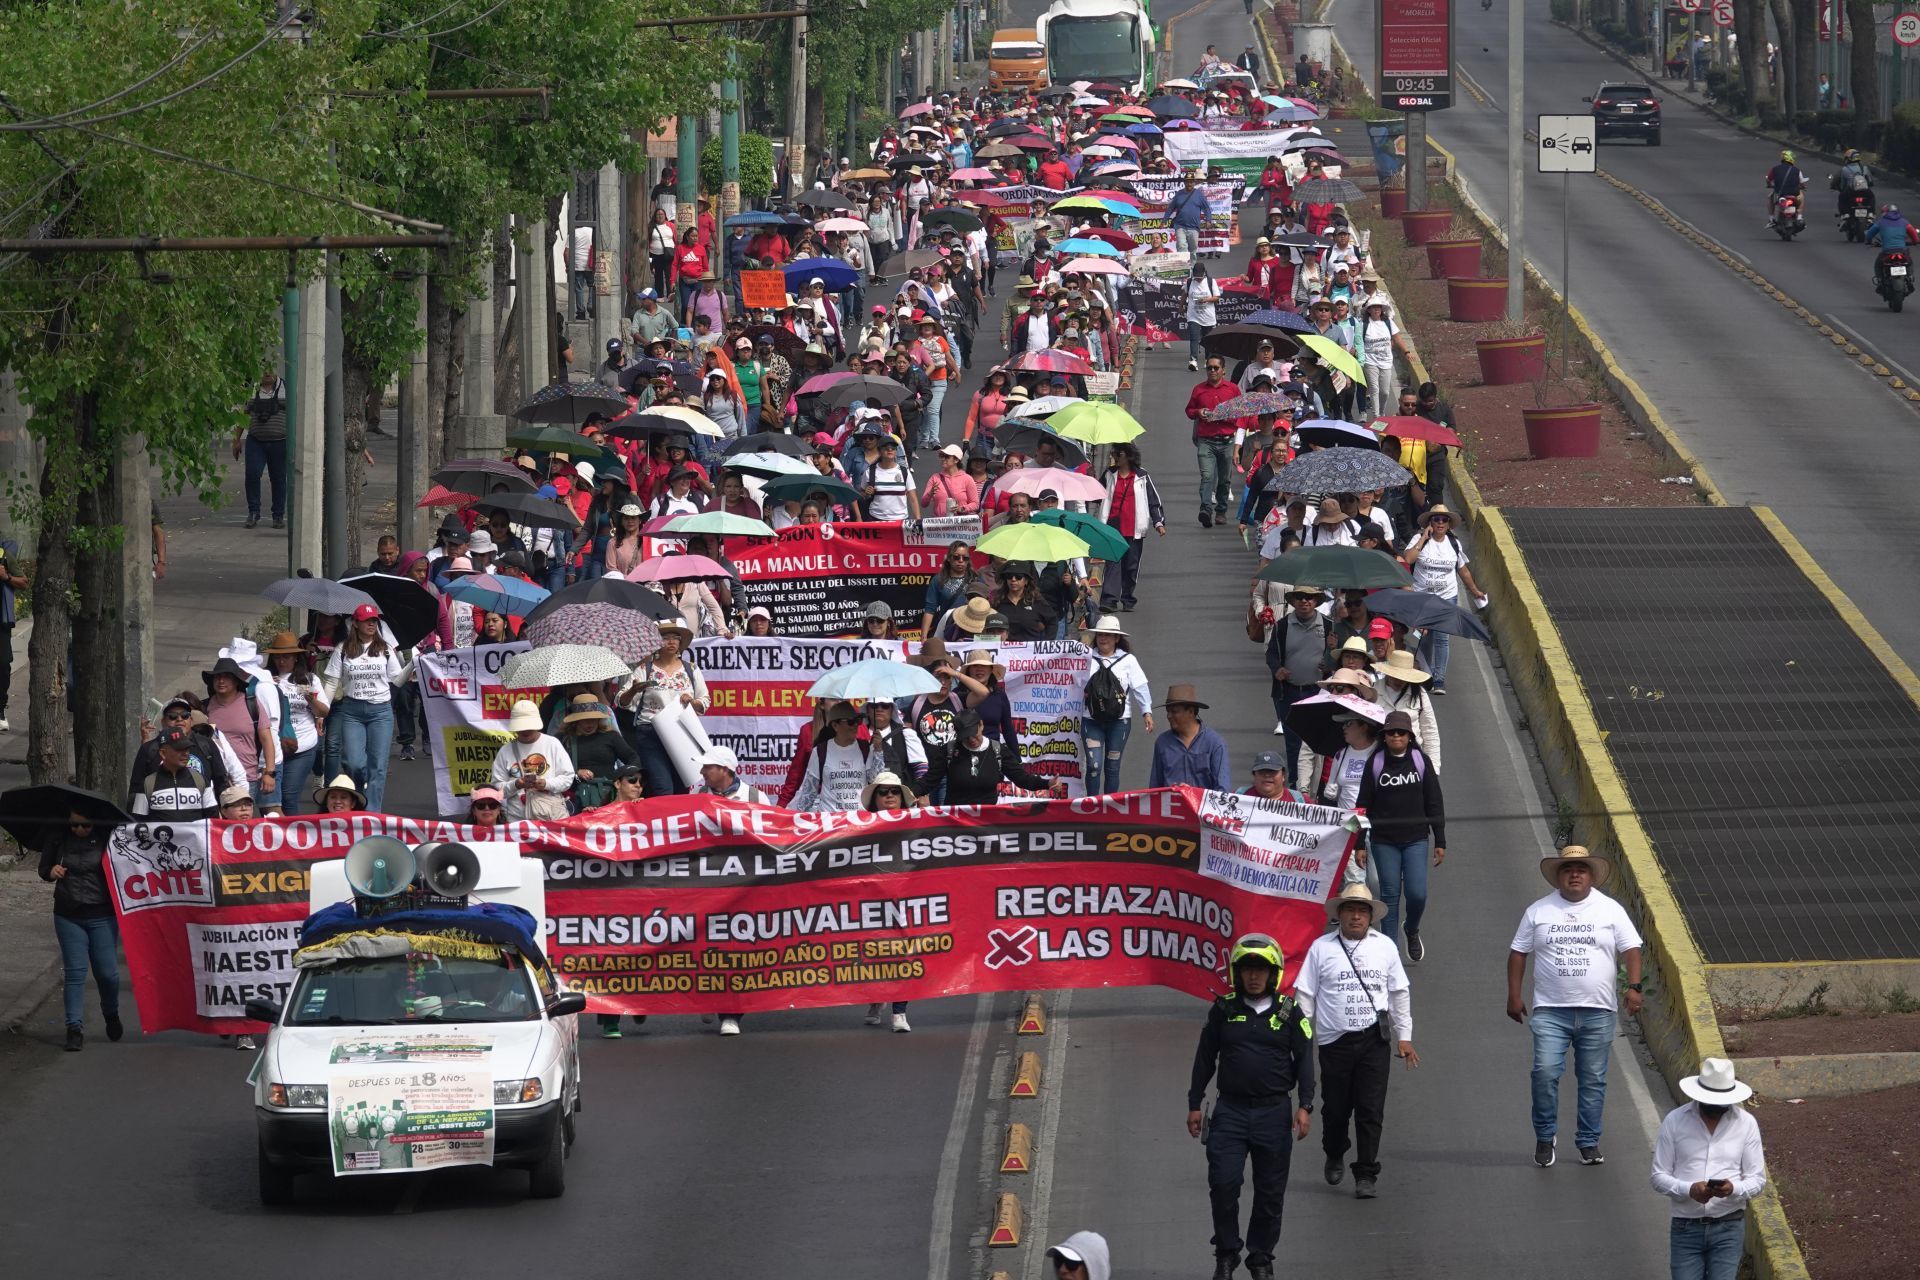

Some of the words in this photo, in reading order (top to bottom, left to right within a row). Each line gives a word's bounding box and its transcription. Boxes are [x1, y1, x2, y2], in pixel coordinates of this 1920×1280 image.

[1901, 20, 1916, 31] 50
[1396, 78, 1434, 91] 09:45
[1165, 181, 1186, 190] PALO
[820, 523, 835, 541] 9
[840, 527, 882, 540] CNTE
[767, 554, 838, 573] MANUEL
[843, 554, 861, 568] C.
[866, 552, 922, 568] TELLO
[782, 582, 795, 591] DE
[799, 581, 809, 590] LA
[810, 580, 826, 589] LEY
[828, 579, 844, 588] DEL
[848, 576, 878, 586] ISSSTE
[881, 575, 899, 585] DEL
[901, 575, 932, 585] 2007
[751, 593, 773, 603] AÑOS
[775, 593, 786, 602] DE
[790, 592, 826, 602] SERVICIO
[774, 604, 820, 614] MAESTROS:
[822, 602, 836, 611] 30
[838, 600, 859, 610] AÑOS
[776, 615, 786, 624] AL
[788, 614, 823, 623] SALARIO
[825, 612, 842, 621] DEL
[843, 610, 867, 620] ÚLTIM
[894, 609, 905, 617] DE
[787, 624, 822, 635] MÍNIMO.
[824, 620, 864, 632] RECHAZAM
[1033, 640, 1090, 656] MAESTR@S
[686, 645, 789, 671] ORIENTE
[790, 641, 894, 670] SECCIÓN
[1009, 657, 1045, 672] REGIÓN
[1047, 658, 1088, 671] ORIENTE
[1023, 672, 1074, 685] IZTAPALAPA
[429, 678, 468, 695] CNTE
[1031, 687, 1061, 699] SECCIÓN
[1063, 689, 1068, 698] 9
[713, 690, 737, 708] DE
[742, 690, 766, 708] LA
[777, 690, 807, 708] LEY
[1014, 699, 1063, 713] DEMOCRÁTICA
[1029, 719, 1059, 735] somos
[1060, 717, 1074, 731] de
[456, 746, 498, 761] MAEST
[1030, 742, 1041, 756] de
[1042, 740, 1077, 756] oriente,
[458, 769, 492, 784] MAES
[743, 764, 757, 775] DE
[1380, 772, 1420, 787] Calvin
[151, 793, 202, 806] Reebok
[585, 809, 779, 854] ORIENTE
[1070, 792, 1185, 820] CNTE
[1203, 813, 1245, 832] CNTE
[1330, 811, 1345, 827] DE
[1268, 825, 1320, 850] MAESTR@S
[1210, 834, 1237, 855] REGIÓN
[1238, 842, 1272, 865] ORIENTE
[1272, 849, 1320, 874] IZTAPALAPA
[222, 869, 311, 895] EXIGI
[643, 857, 690, 877] DE
[699, 855, 746, 876] LA
[754, 851, 819, 875] LEY
[828, 844, 893, 868] DEL
[901, 833, 1019, 861] ISSSTE
[1029, 832, 1097, 851] DEL
[1105, 832, 1197, 859] 2007
[1206, 854, 1232, 877] SECCIÓN
[1233, 868, 1239, 879] 9
[1240, 866, 1297, 892] DEMOCRÁTICA
[1297, 879, 1320, 896] CNTE
[124, 869, 204, 900] CNTE
[545, 909, 695, 944] PENSIÓN
[706, 895, 949, 943] EQUIVALENTE
[996, 886, 1235, 939] RECHAZAMOS
[201, 925, 288, 944] JUBILACIÓN
[1548, 923, 1595, 935] ¡EXIGIMOS!
[1546, 936, 1554, 945] LA
[1554, 935, 1596, 945] ABROGACIÓN
[563, 956, 652, 973] SALARIO
[658, 953, 697, 969] DEL
[703, 948, 778, 968] ÚLTIMO
[783, 943, 826, 964] AÑO
[833, 942, 859, 959] DE
[865, 935, 952, 958] SERVICIO
[1037, 929, 1110, 961] LAS
[1123, 928, 1218, 972] UMAS
[1556, 947, 1565, 955] DE
[1566, 947, 1574, 955] LA
[1575, 947, 1587, 956] LEY
[1555, 958, 1567, 966] DEL
[1567, 958, 1591, 966] ISSSTE
[568, 975, 692, 993] CALCULADO
[698, 975, 725, 991] EN
[731, 967, 830, 991] SALARIOS
[836, 961, 924, 983] MÍNIMOS
[1558, 969, 1571, 977] DEL
[1571, 969, 1588, 977] 2007
[1347, 995, 1356, 1004] DE
[1356, 995, 1364, 1003] LA
[1345, 1006, 1356, 1015] DEL
[1357, 1006, 1373, 1015] ISSST
[1348, 1018, 1360, 1027] DEL
[348, 1077, 390, 1088] DESPUÉS
[394, 1077, 406, 1085] DE
[410, 1072, 437, 1086] 18
[440, 1074, 466, 1082] AÑOS
[412, 1144, 424, 1153] 28
[449, 1141, 461, 1149] 30
